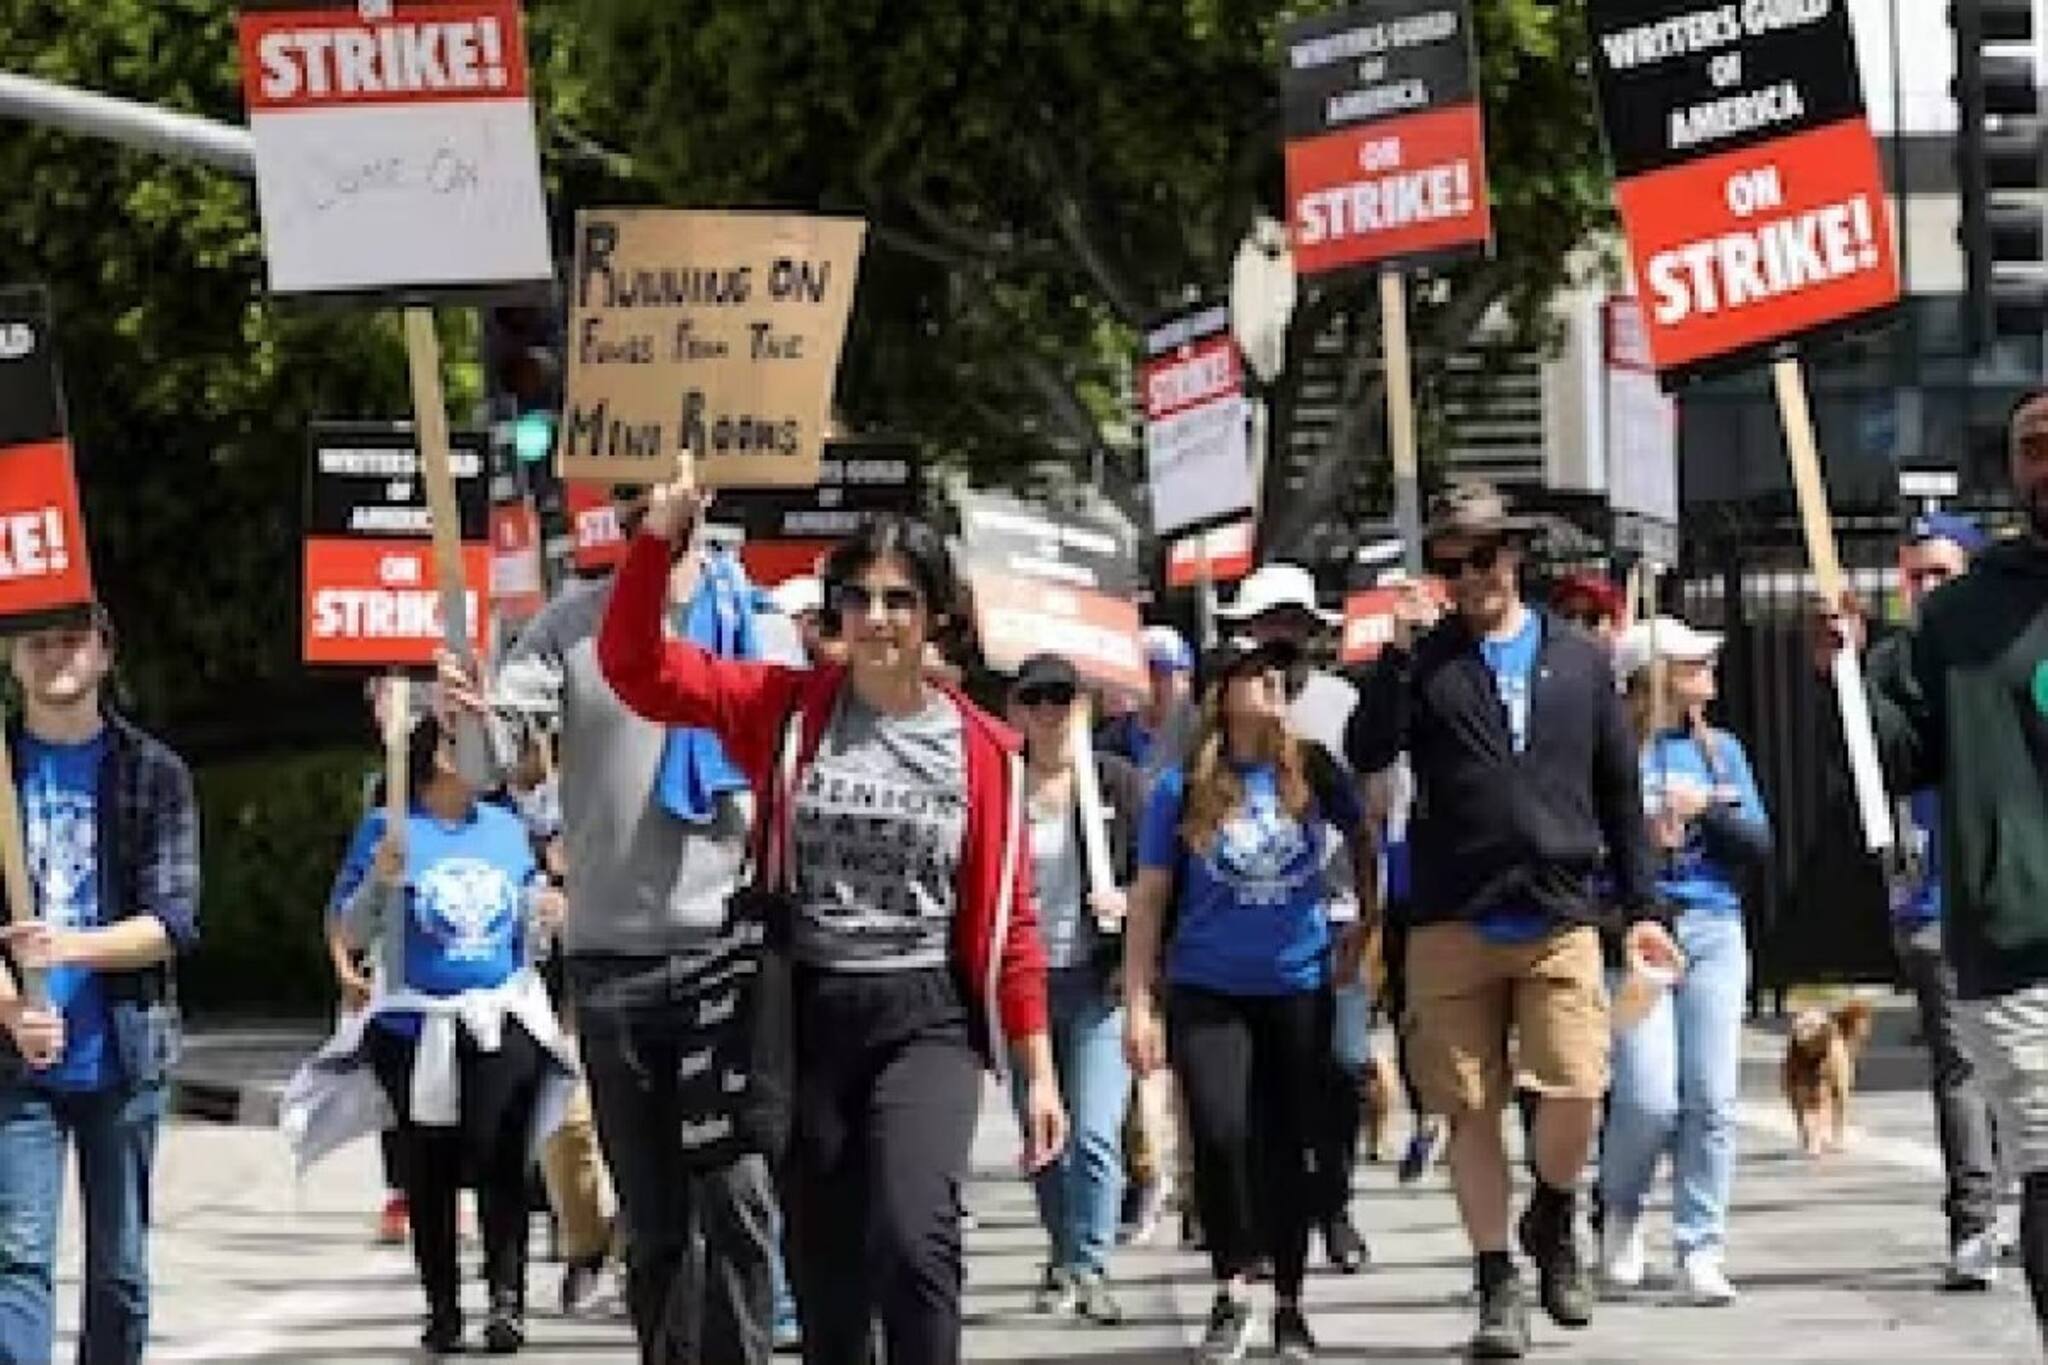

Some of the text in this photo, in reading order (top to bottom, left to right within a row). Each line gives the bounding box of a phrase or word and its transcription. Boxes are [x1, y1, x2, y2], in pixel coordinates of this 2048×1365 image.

[260, 17, 507, 98] STRIKE!
[1706, 52, 1742, 87] OF
[1325, 79, 1430, 127] AMERICA
[1667, 80, 1804, 149] AMERICA
[1358, 137, 1400, 171] ON
[1297, 159, 1474, 245] STRIKE!
[1726, 165, 1782, 217] ON
[768, 256, 832, 303] ON
[1648, 194, 1879, 324] STRIKE!
[680, 387, 799, 460] ROOMS
[312, 589, 479, 639] STRIK!
